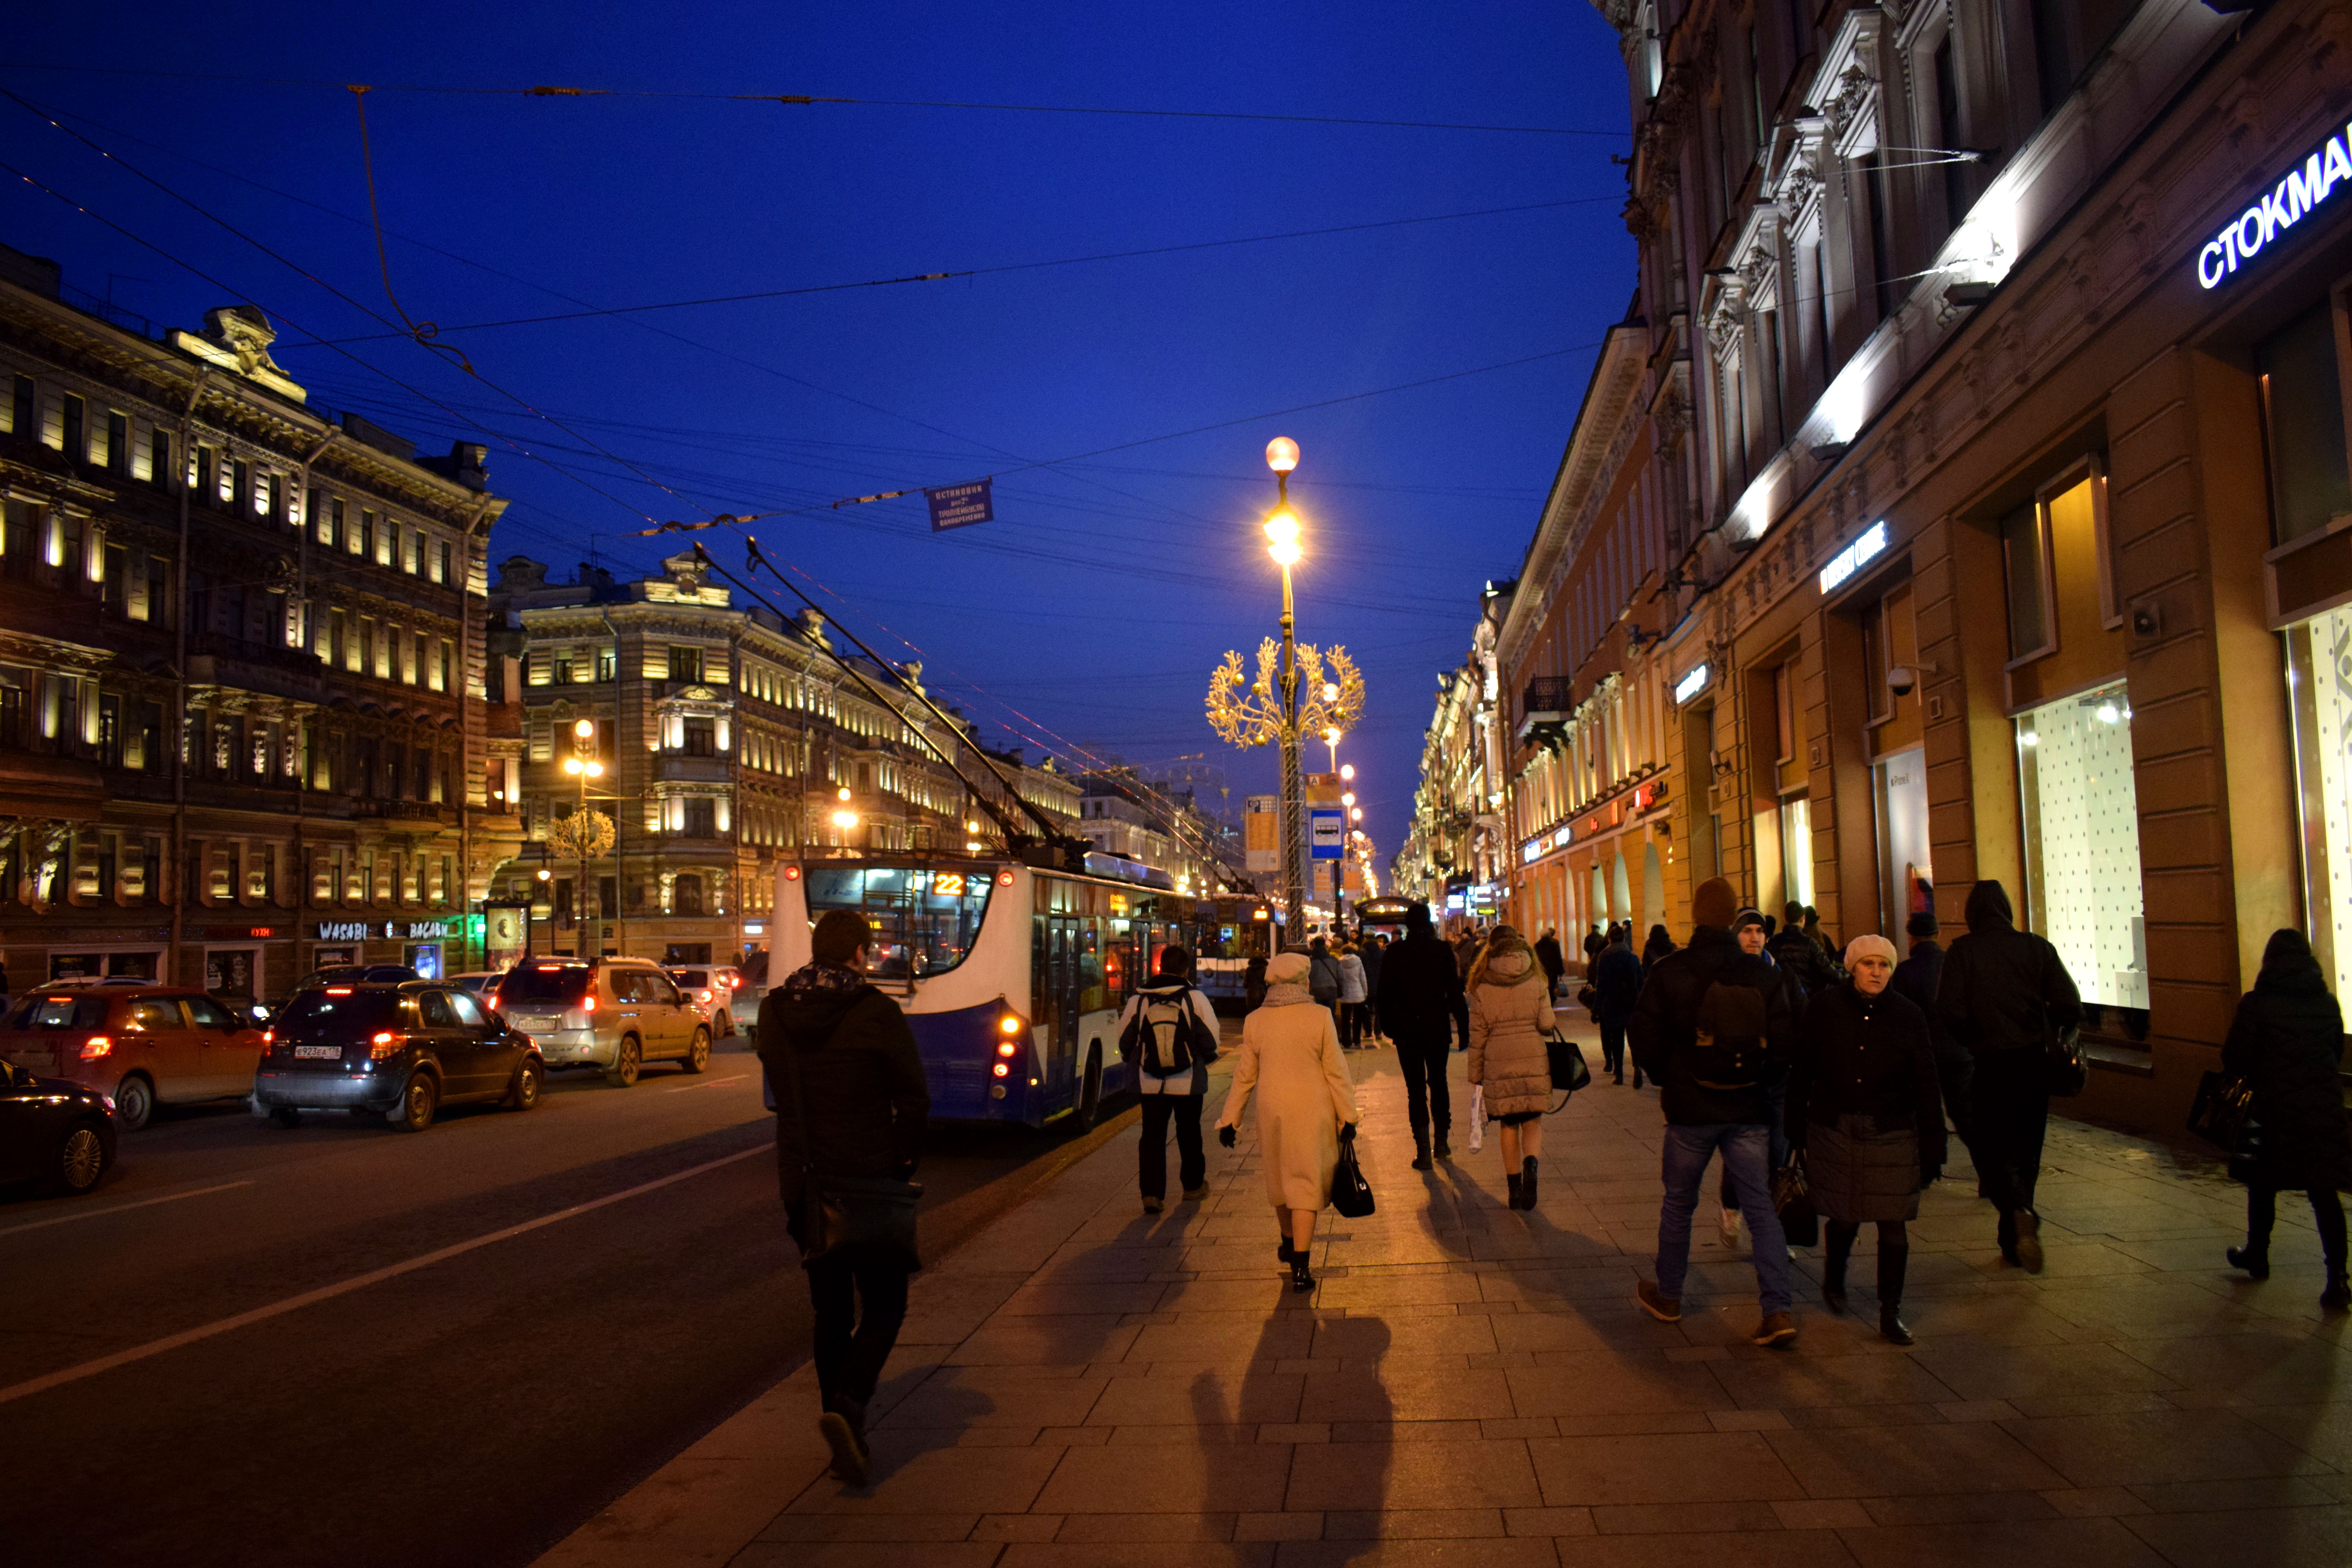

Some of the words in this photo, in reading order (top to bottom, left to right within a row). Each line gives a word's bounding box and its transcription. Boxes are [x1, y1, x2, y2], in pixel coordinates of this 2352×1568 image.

[935, 874, 963, 895] 22
[319, 920, 368, 941] WASABI
[410, 921, 448, 939] ВАСАБИ
